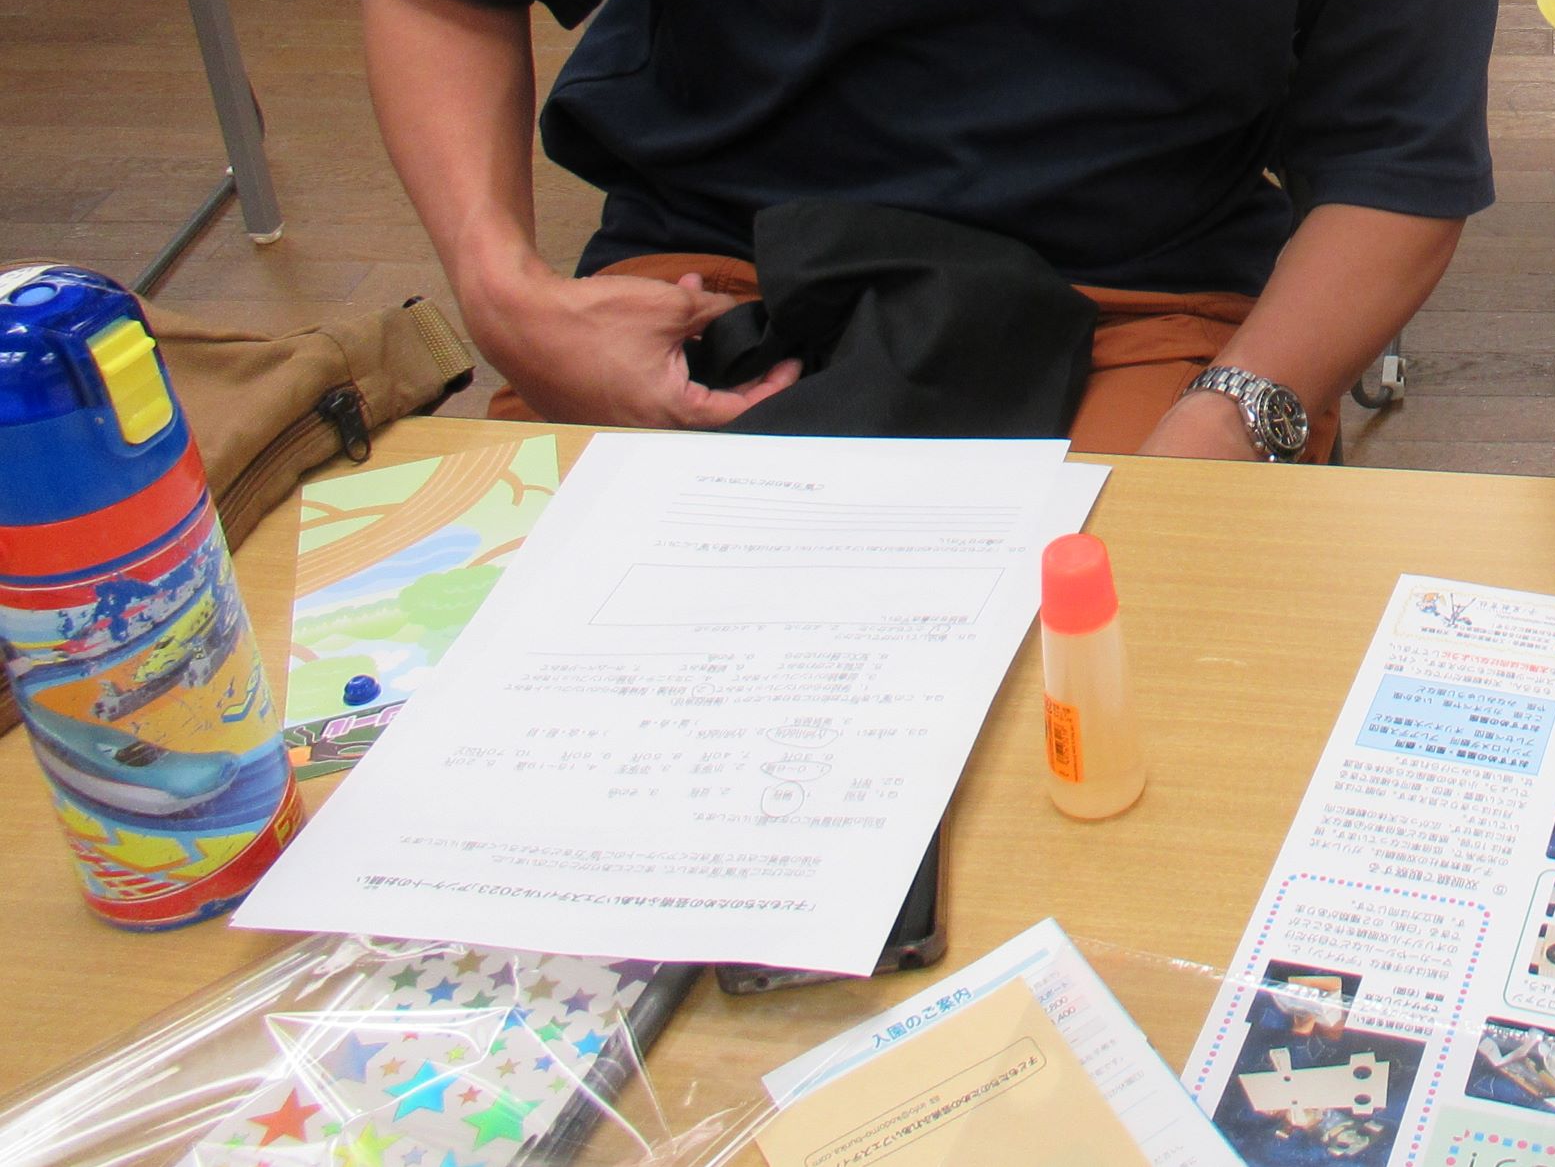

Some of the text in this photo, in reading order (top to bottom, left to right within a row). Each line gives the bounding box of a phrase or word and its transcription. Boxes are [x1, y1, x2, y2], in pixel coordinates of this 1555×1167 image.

[1372, 713, 1464, 734] オリオン大星雲など
[1448, 737, 1532, 756] アンドロメダ銀河
[1365, 861, 1480, 890] 双眼鏡で観察する
[1283, 928, 1454, 967] マーカーやシールなどで自分だけ
[1287, 916, 1459, 954] のオリジナル双眼鏡を作ることが
[872, 987, 972, 1048] 入園のご案内
[836, 1055, 1038, 1167] 子どもたちのための芸術ふれあいフェスティ
